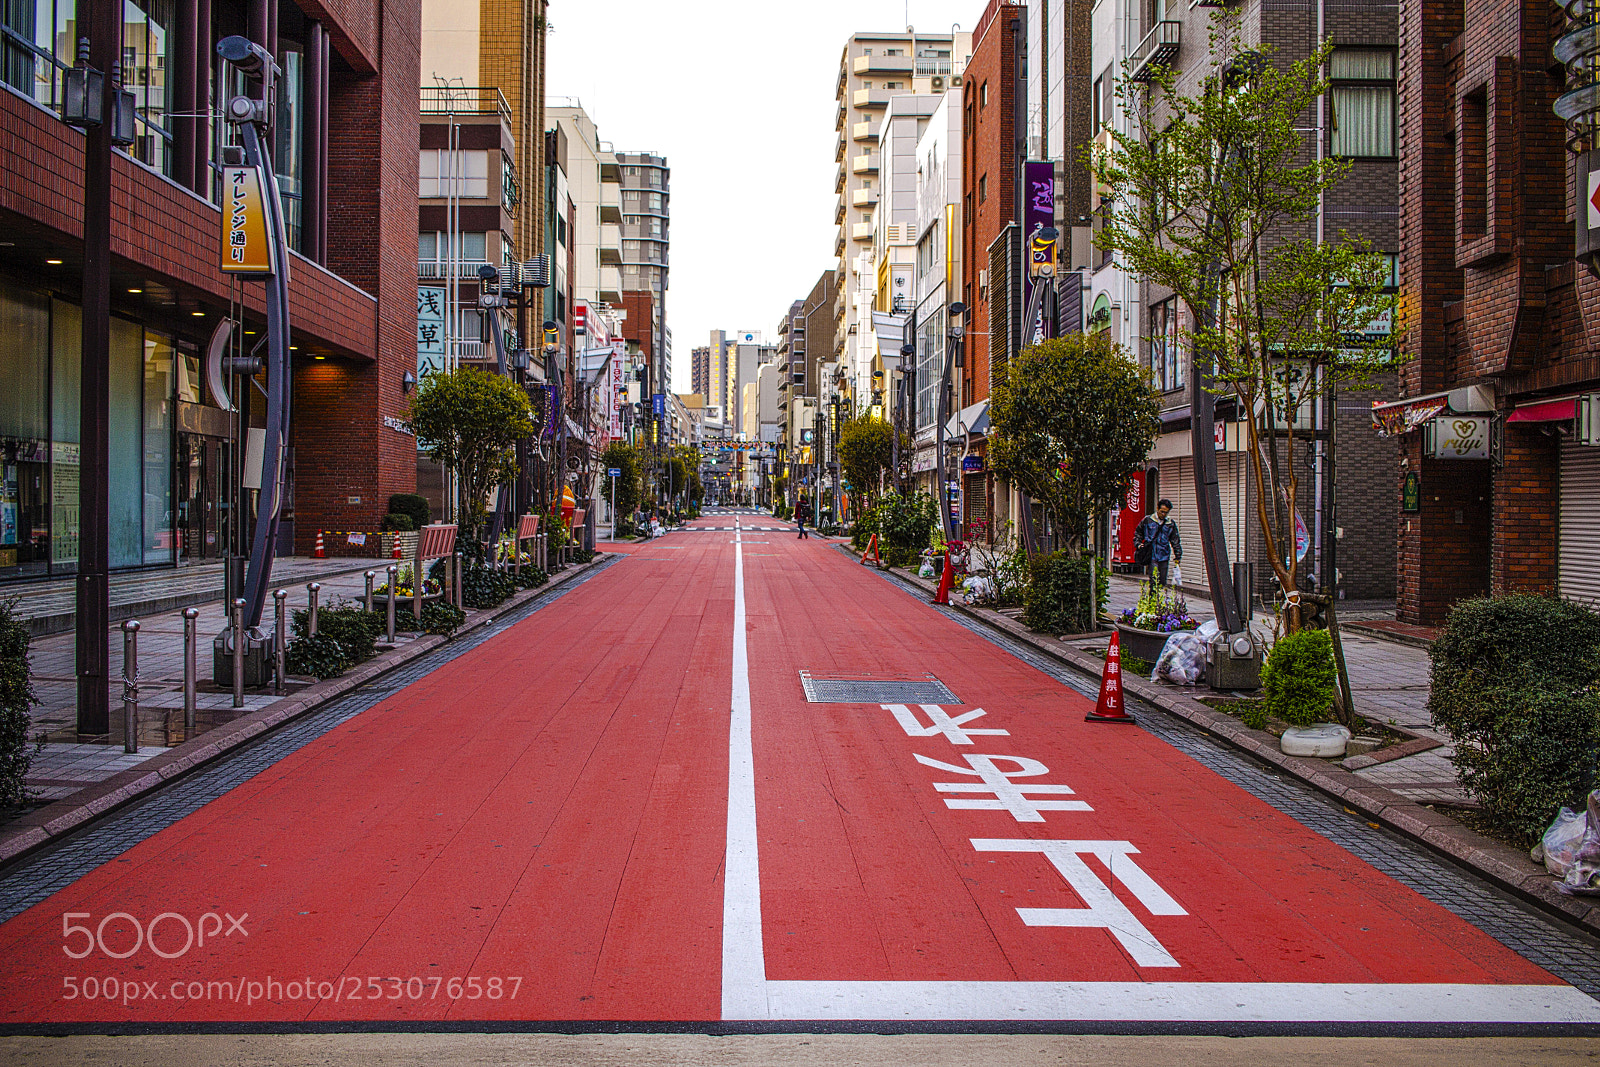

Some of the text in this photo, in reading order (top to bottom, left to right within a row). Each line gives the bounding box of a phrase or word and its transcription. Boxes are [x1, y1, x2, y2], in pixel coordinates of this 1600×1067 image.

[230, 170, 247, 263] オレンジ通り
[613, 360, 622, 383] Tax
[1442, 434, 1483, 456] ruyi
[1105, 644, 1120, 708] 駐車禁止
[880, 704, 1190, 968] 止まれ
